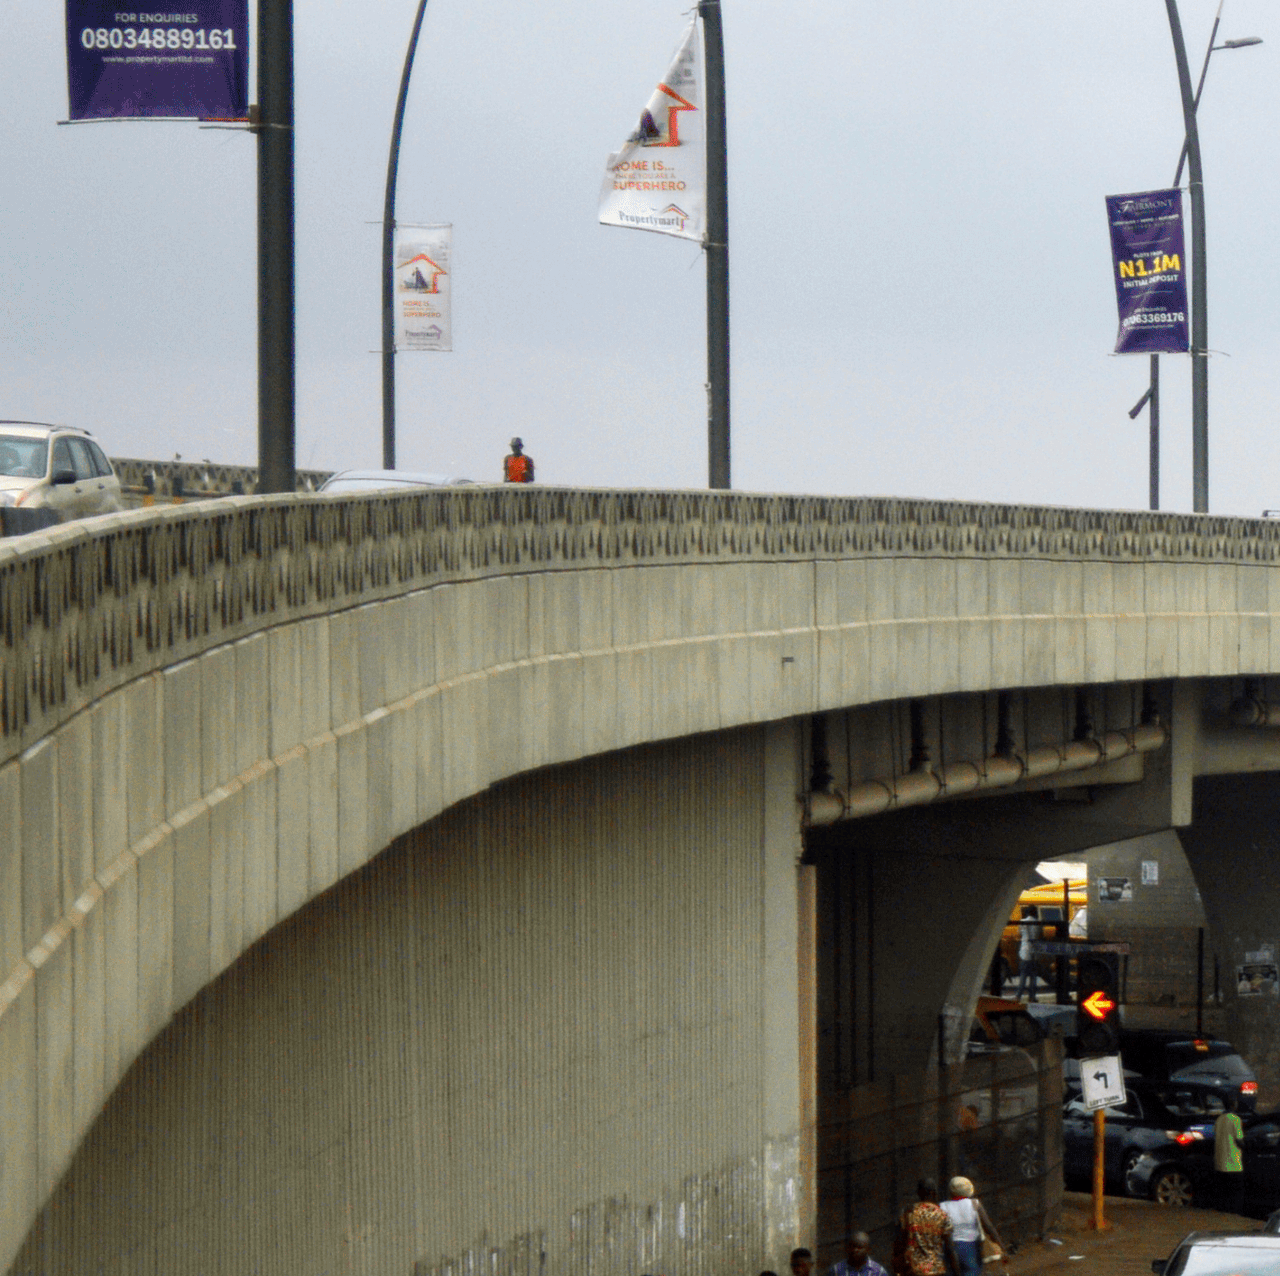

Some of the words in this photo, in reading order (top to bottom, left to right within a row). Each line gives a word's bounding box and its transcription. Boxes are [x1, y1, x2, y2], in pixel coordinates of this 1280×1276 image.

[115, 13, 137, 23] FOR
[140, 13, 199, 23] ENQUIRIES
[81, 28, 237, 49] 08034889161
[613, 180, 687, 191] SUPERHERO
[618, 210, 680, 226] Propertymart
[1119, 254, 1181, 278] N1.1M
